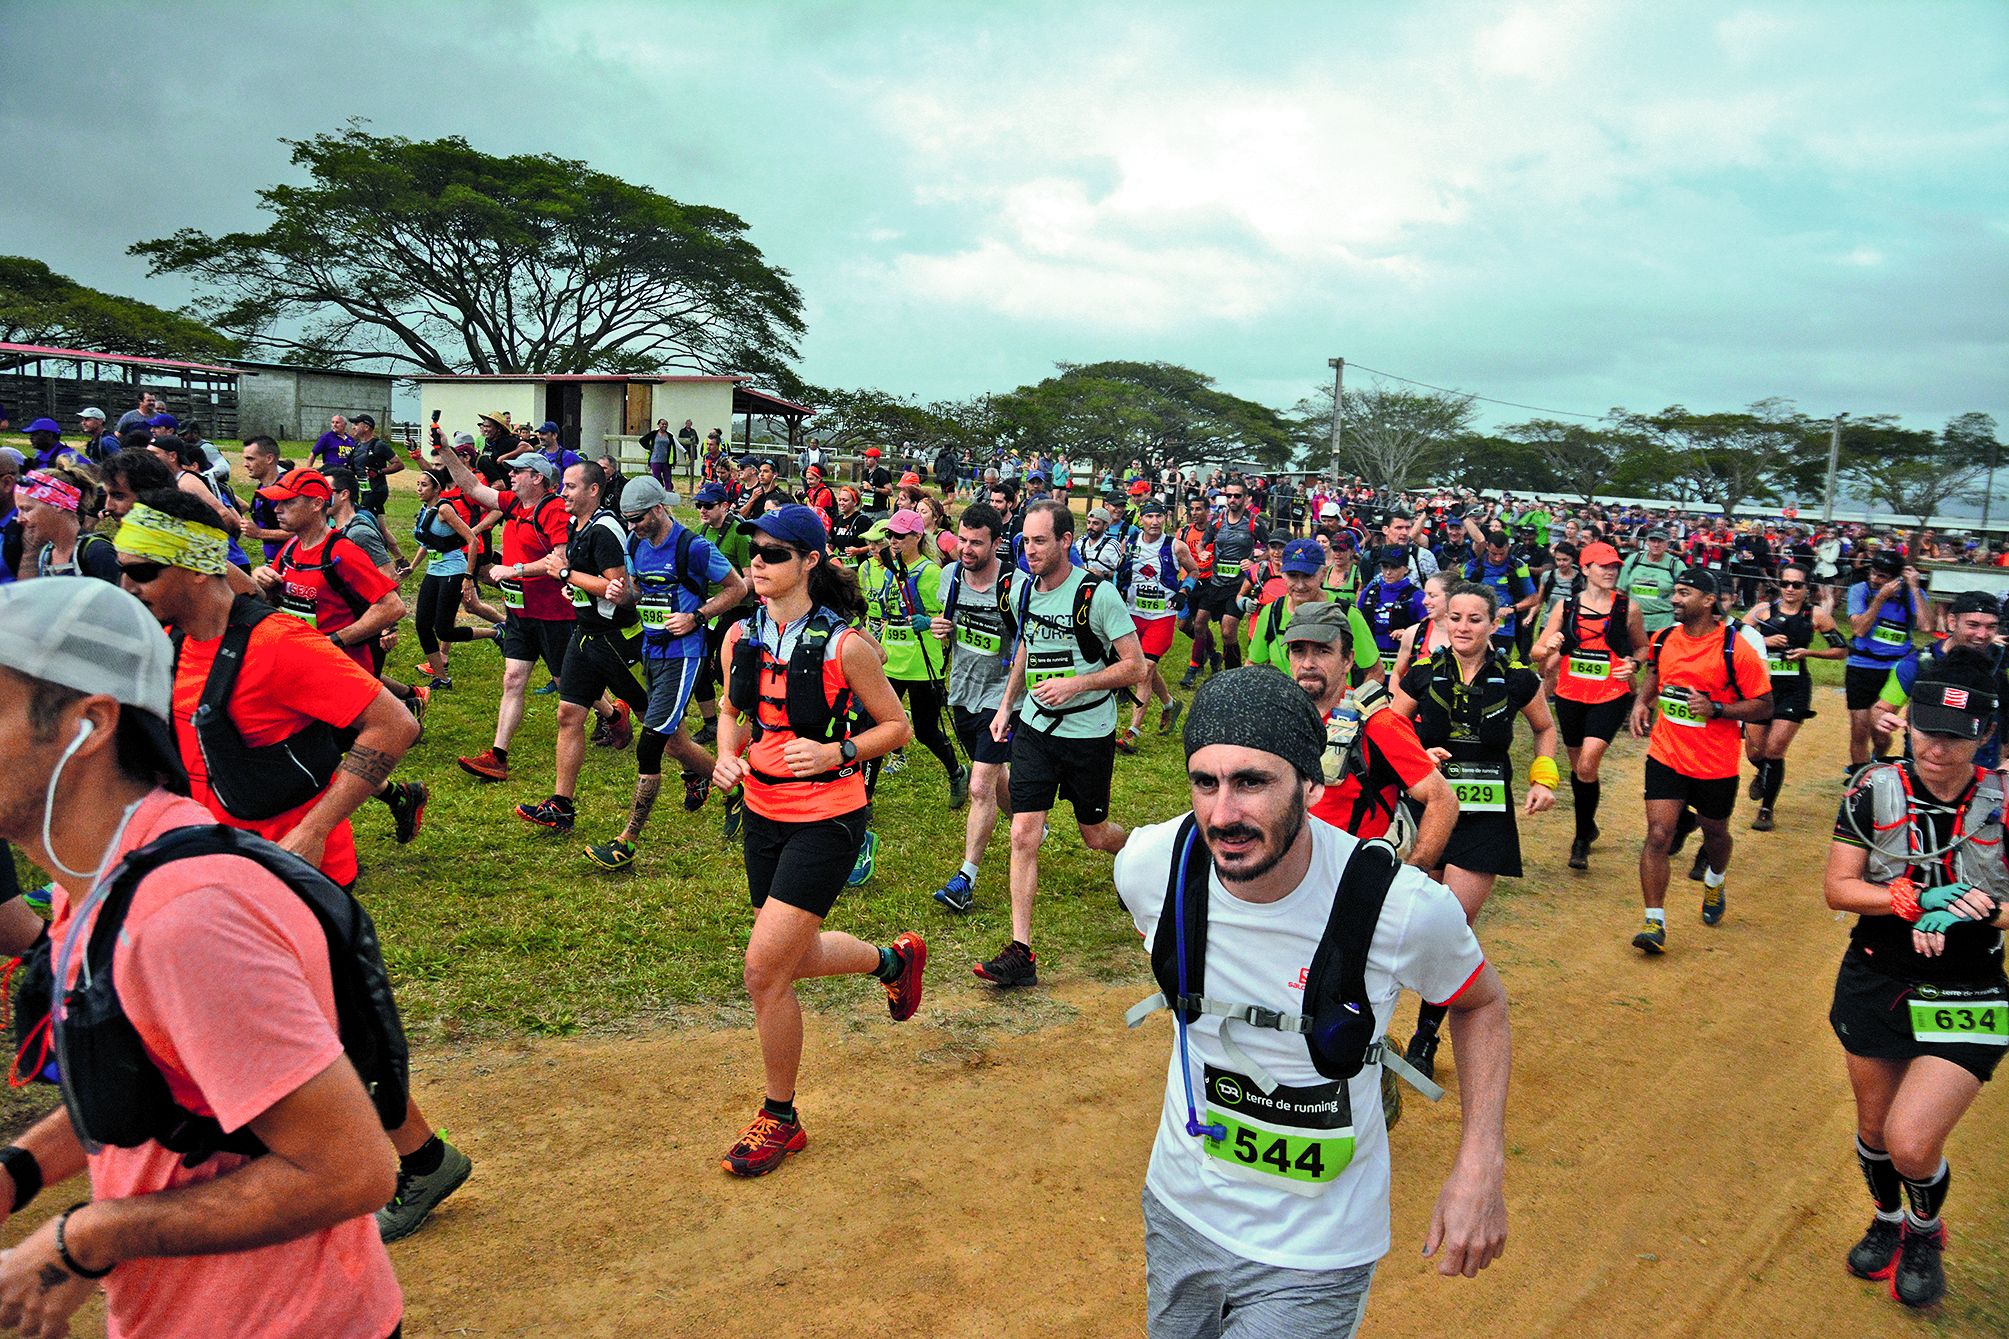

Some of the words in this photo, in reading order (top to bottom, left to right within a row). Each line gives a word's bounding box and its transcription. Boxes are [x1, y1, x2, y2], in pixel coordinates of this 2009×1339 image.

[1141, 600, 1159, 610] 576
[642, 610, 664, 623] 598
[964, 631, 991, 649] 553
[1577, 662, 1602, 675] 649
[1770, 661, 1793, 671] 618
[1668, 703, 1697, 720] 56
[1456, 785, 1493, 803] 629
[1941, 989, 1962, 997] terre
[1934, 1008, 1996, 1032] 634
[1245, 1091, 1274, 1108] terre
[1275, 1099, 1292, 1111] de
[1293, 1100, 1339, 1113] running
[1233, 1126, 1325, 1178] 544
